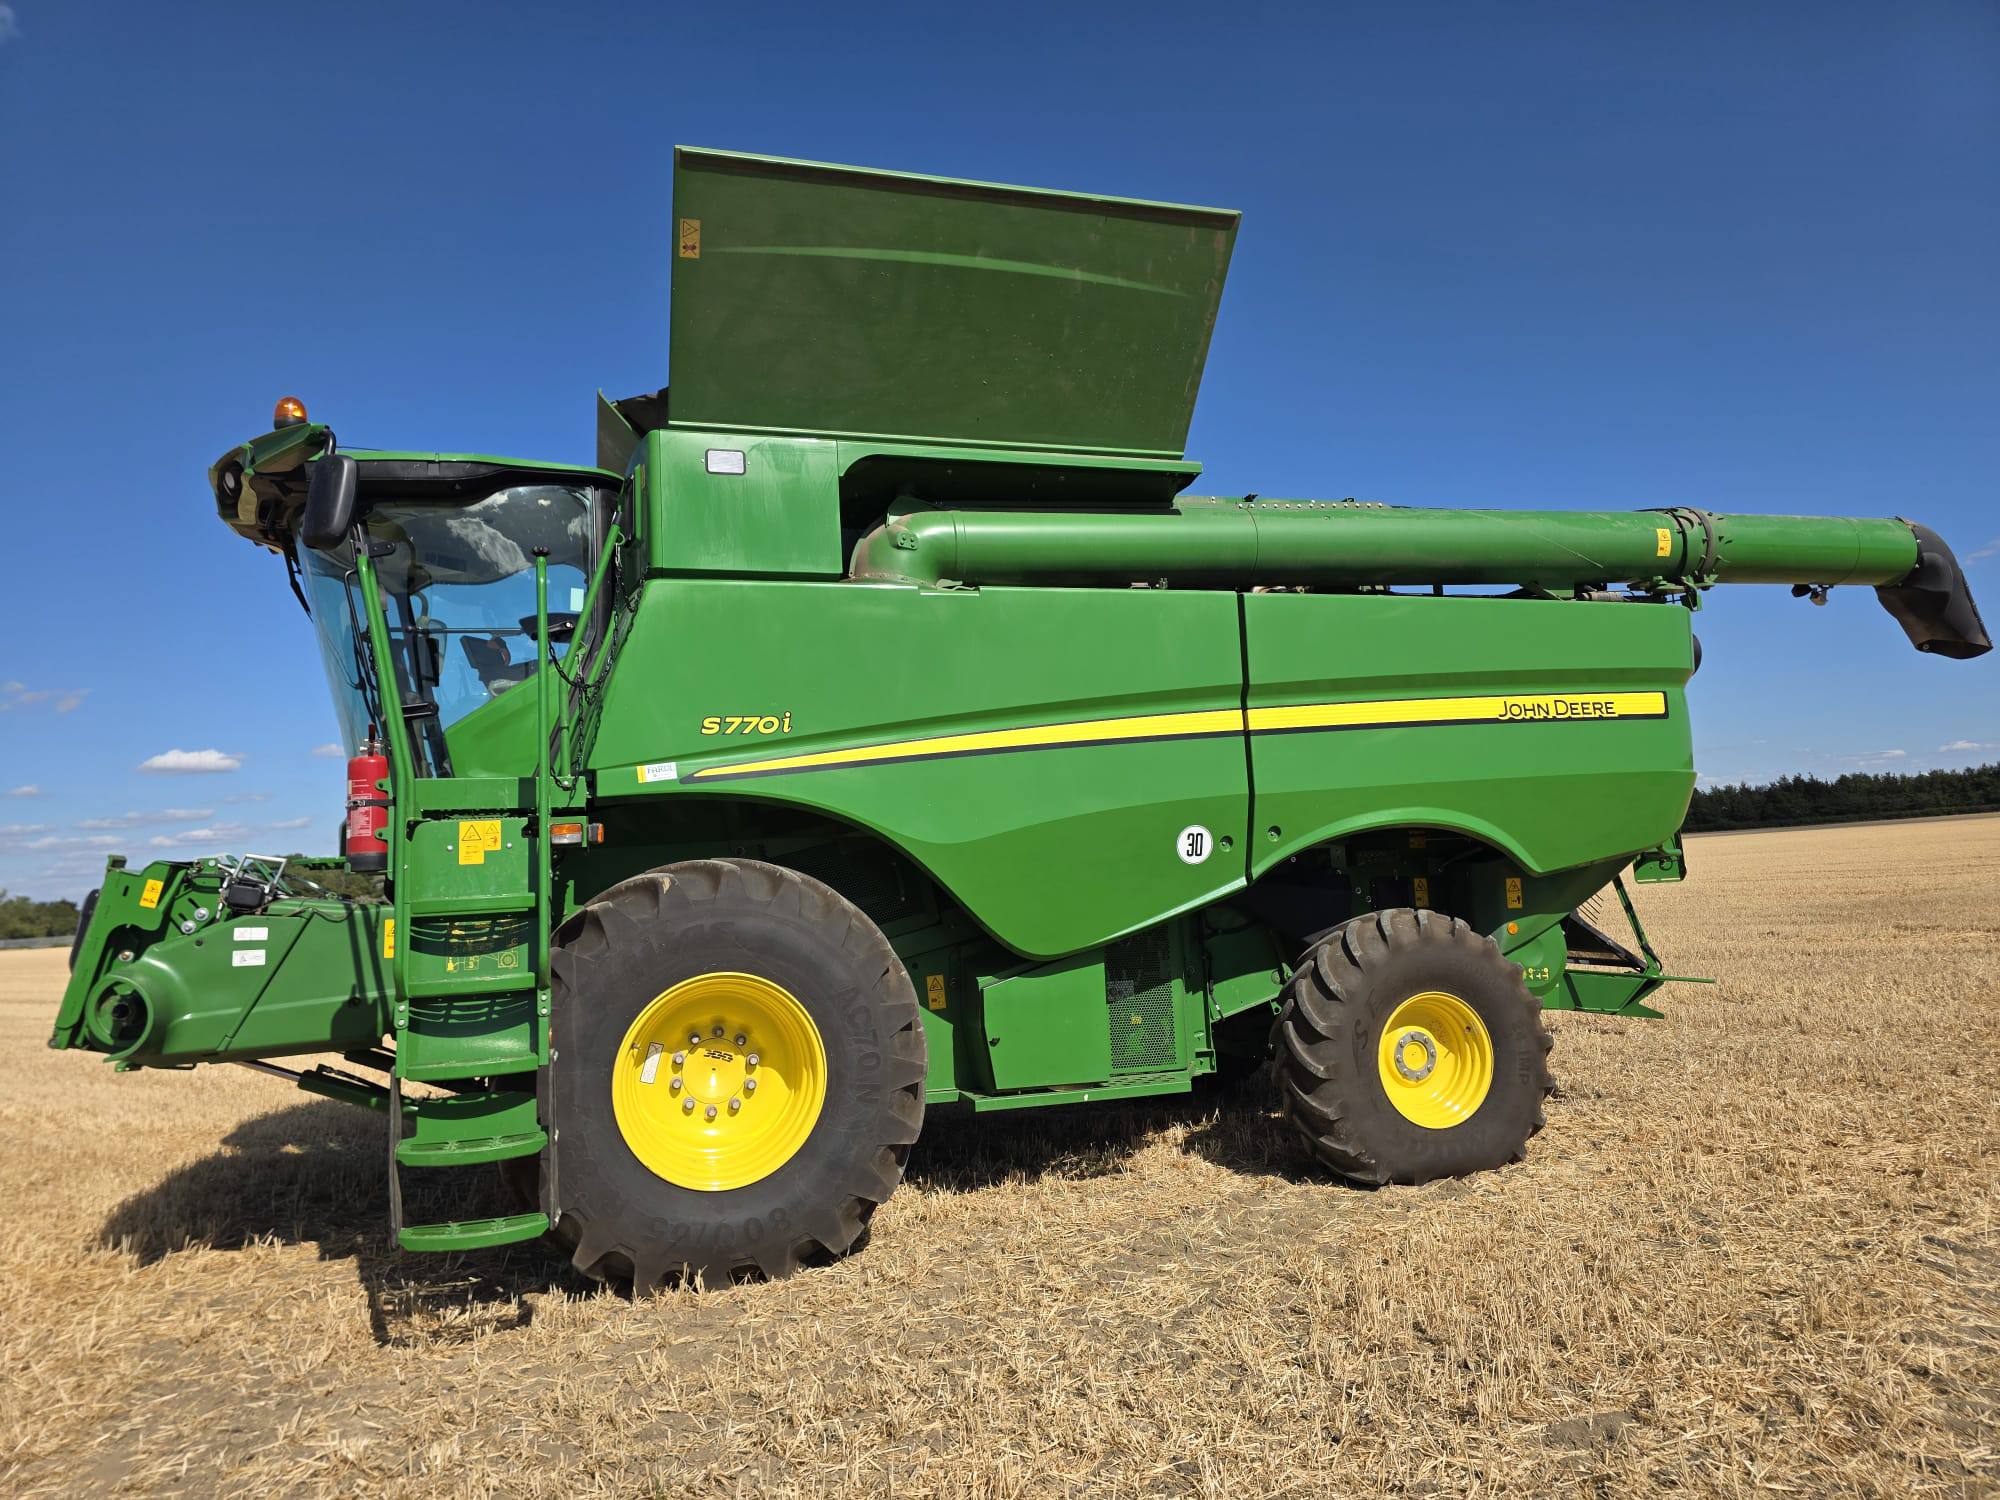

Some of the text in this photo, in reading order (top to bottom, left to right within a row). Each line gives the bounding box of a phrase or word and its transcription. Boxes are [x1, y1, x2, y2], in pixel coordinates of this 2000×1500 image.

[1498, 699, 1617, 718] JOHN DEERE
[1186, 832, 1204, 857] 30
